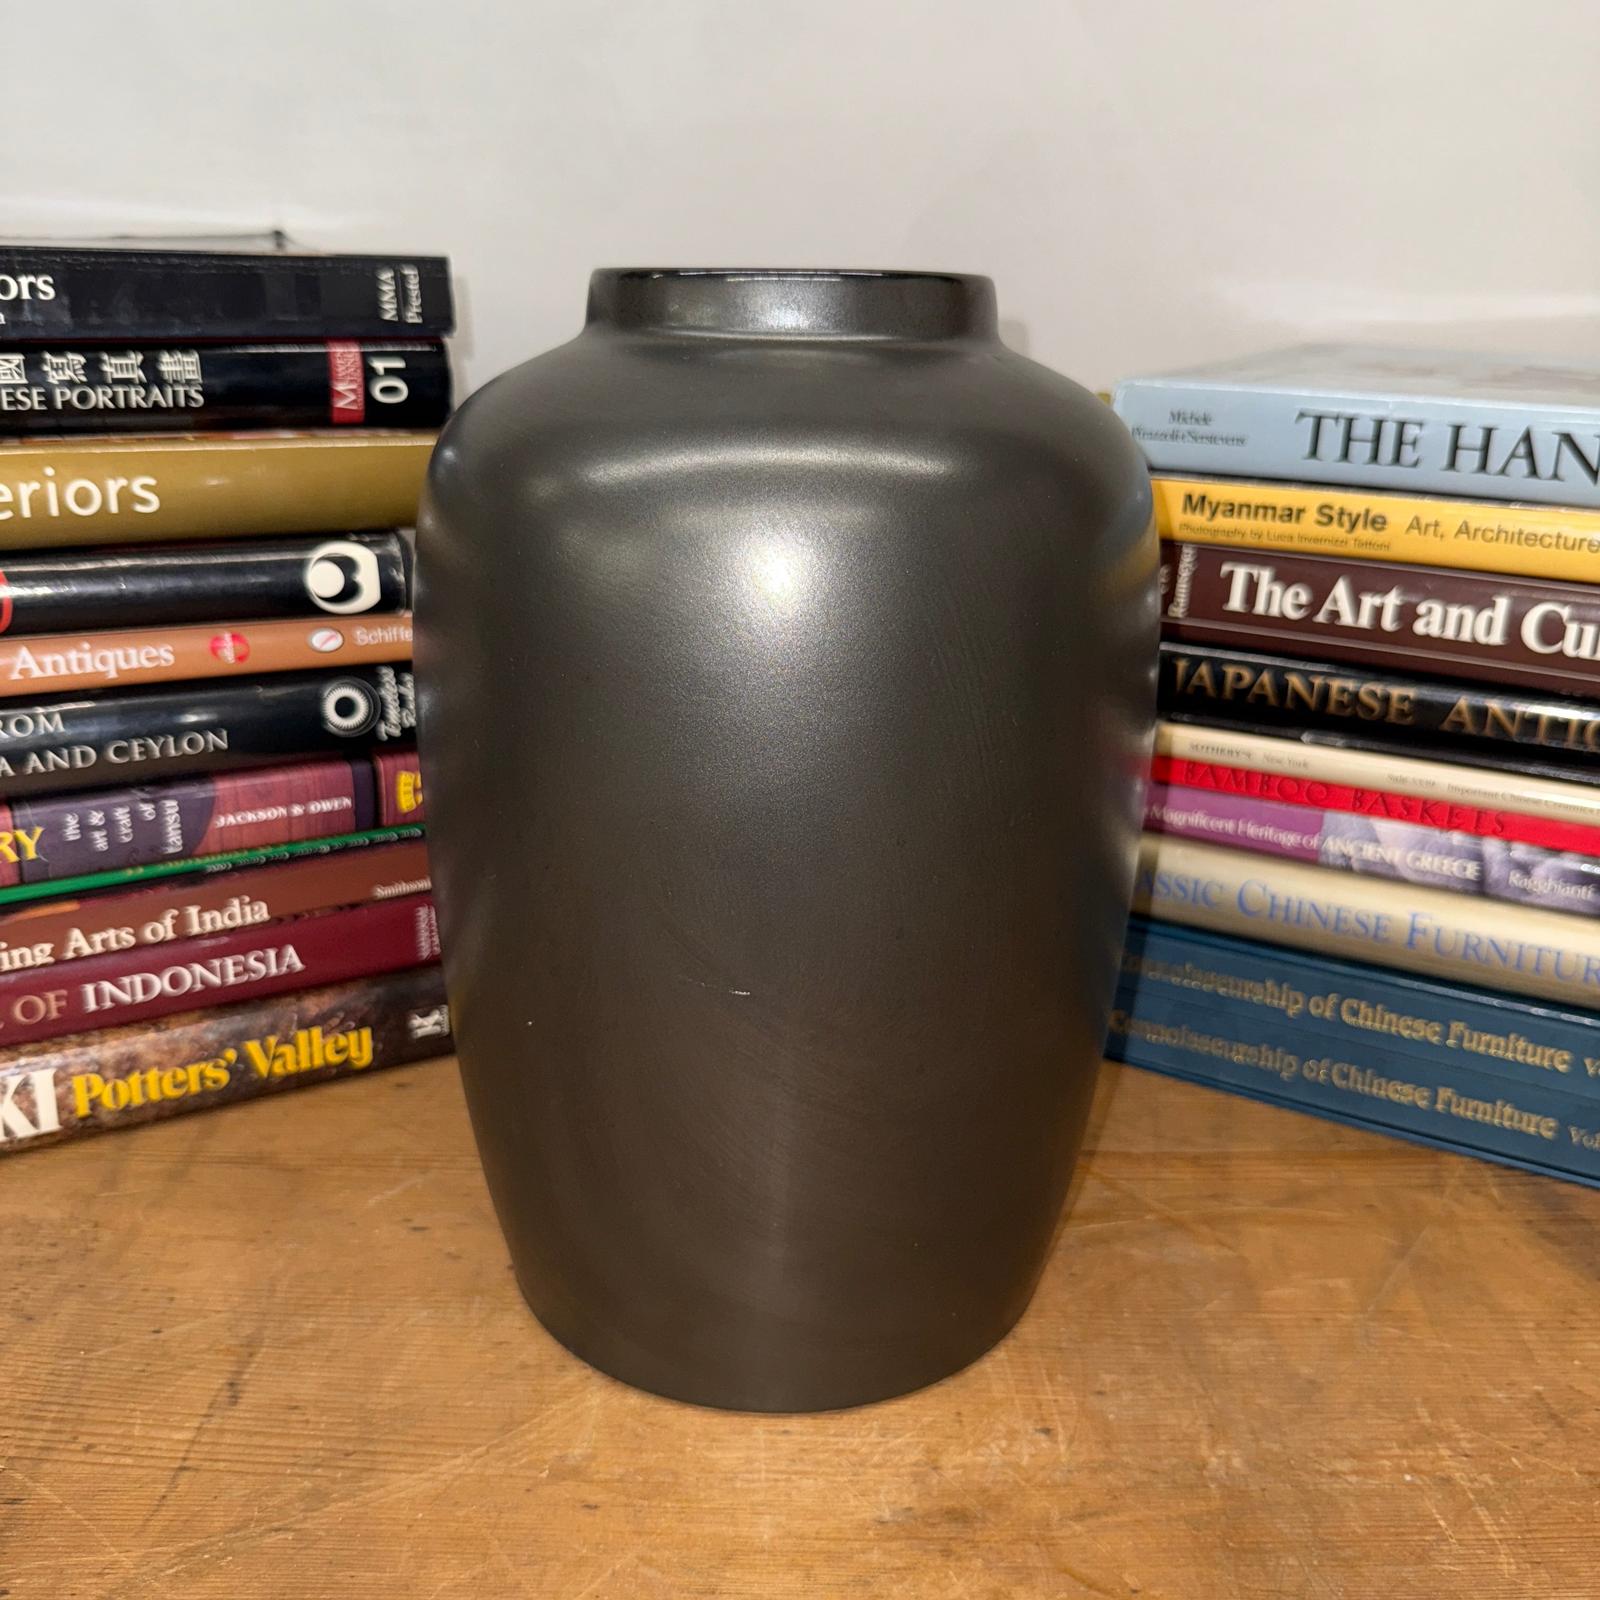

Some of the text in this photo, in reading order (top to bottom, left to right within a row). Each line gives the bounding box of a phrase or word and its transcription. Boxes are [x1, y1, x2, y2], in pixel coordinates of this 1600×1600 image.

[0, 274, 56, 300] ors
[374, 266, 399, 322] MMA
[401, 263, 423, 324] Prestel
[54, 383, 204, 410] PORTRAITS
[368, 356, 409, 404] 01
[1295, 409, 1600, 487] THE HAN
[0, 466, 160, 520] eriors
[1181, 493, 1600, 554] Myanmar Style Art, Architecture
[1177, 522, 1247, 540] Photography
[1249, 529, 1264, 542] by
[1220, 560, 1313, 621] The
[1312, 575, 1402, 632] Art
[1412, 594, 1512, 646] and
[1520, 600, 1600, 661] Cu
[8, 641, 176, 680] Antiques
[1173, 657, 1420, 726] JAPANESE
[22, 743, 98, 776] AND
[102, 728, 230, 765] CEYLON
[215, 796, 352, 829] JACKSON & OWEN
[1183, 760, 1506, 836] BAMBOO BASKETS
[1238, 818, 1302, 849] Heritage
[1301, 832, 1322, 850] of
[1320, 834, 1400, 865] ANCIENT
[1405, 850, 1483, 882] GREECE
[59, 926, 137, 960] Arts
[141, 908, 180, 945] of
[182, 894, 271, 937] India
[12, 943, 306, 1026] OF INDONESIA
[244, 1025, 375, 1080] Valley
[1308, 992, 1341, 1022] of
[1340, 997, 1446, 1047] Chinese
[1446, 1019, 1575, 1075] Furniture
[1302, 1056, 1333, 1086] of
[1331, 1061, 1435, 1111] Chinese
[1435, 1086, 1560, 1142] Furniture
